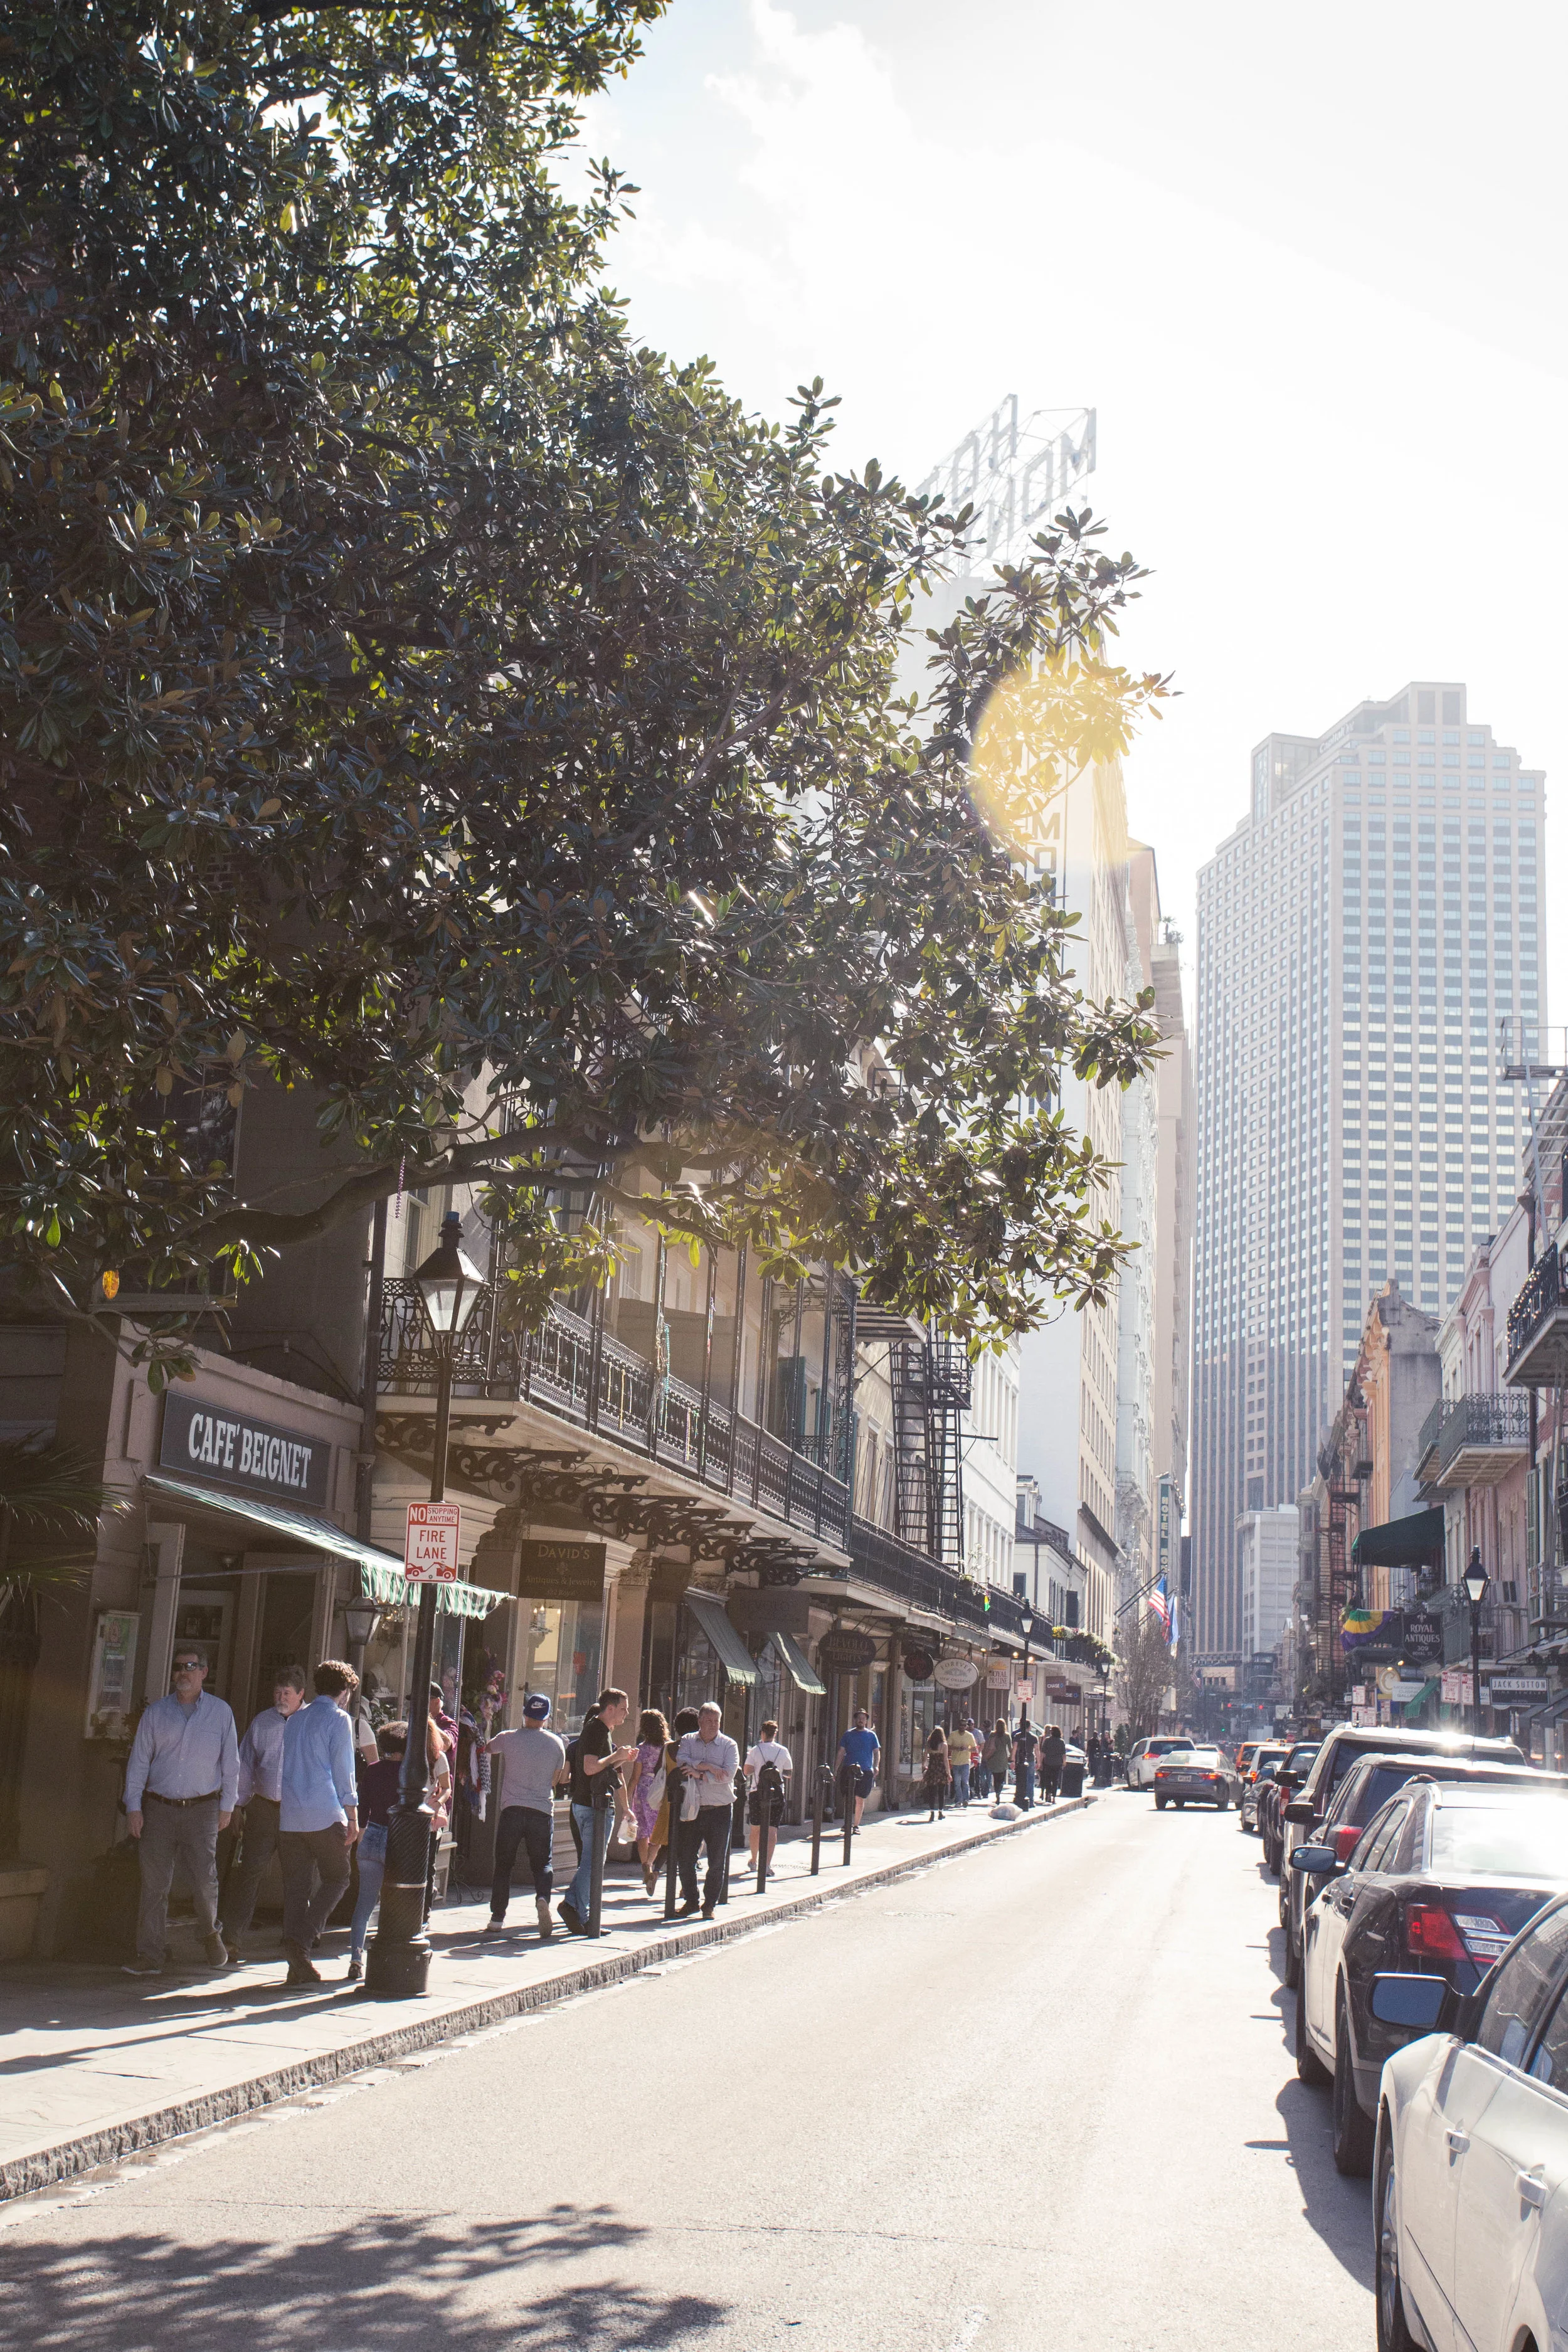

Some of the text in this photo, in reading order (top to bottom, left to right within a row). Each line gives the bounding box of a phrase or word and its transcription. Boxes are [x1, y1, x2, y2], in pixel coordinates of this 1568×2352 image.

[238, 1431, 312, 1489] BEIGNET
[410, 1507, 426, 1522] NO
[419, 1530, 446, 1543] FIRE
[416, 1547, 447, 1560] LANE
[525, 1575, 559, 1586] Antiques
[569, 1577, 598, 1587] Jewelry
[1410, 1624, 1434, 1633] ROYAL
[1404, 1633, 1440, 1645] ANTIQUES
[832, 1651, 862, 1663] LIGHTS
[940, 1661, 972, 1673] FOREVER
[1493, 1680, 1545, 1688] JACK SUTTON
